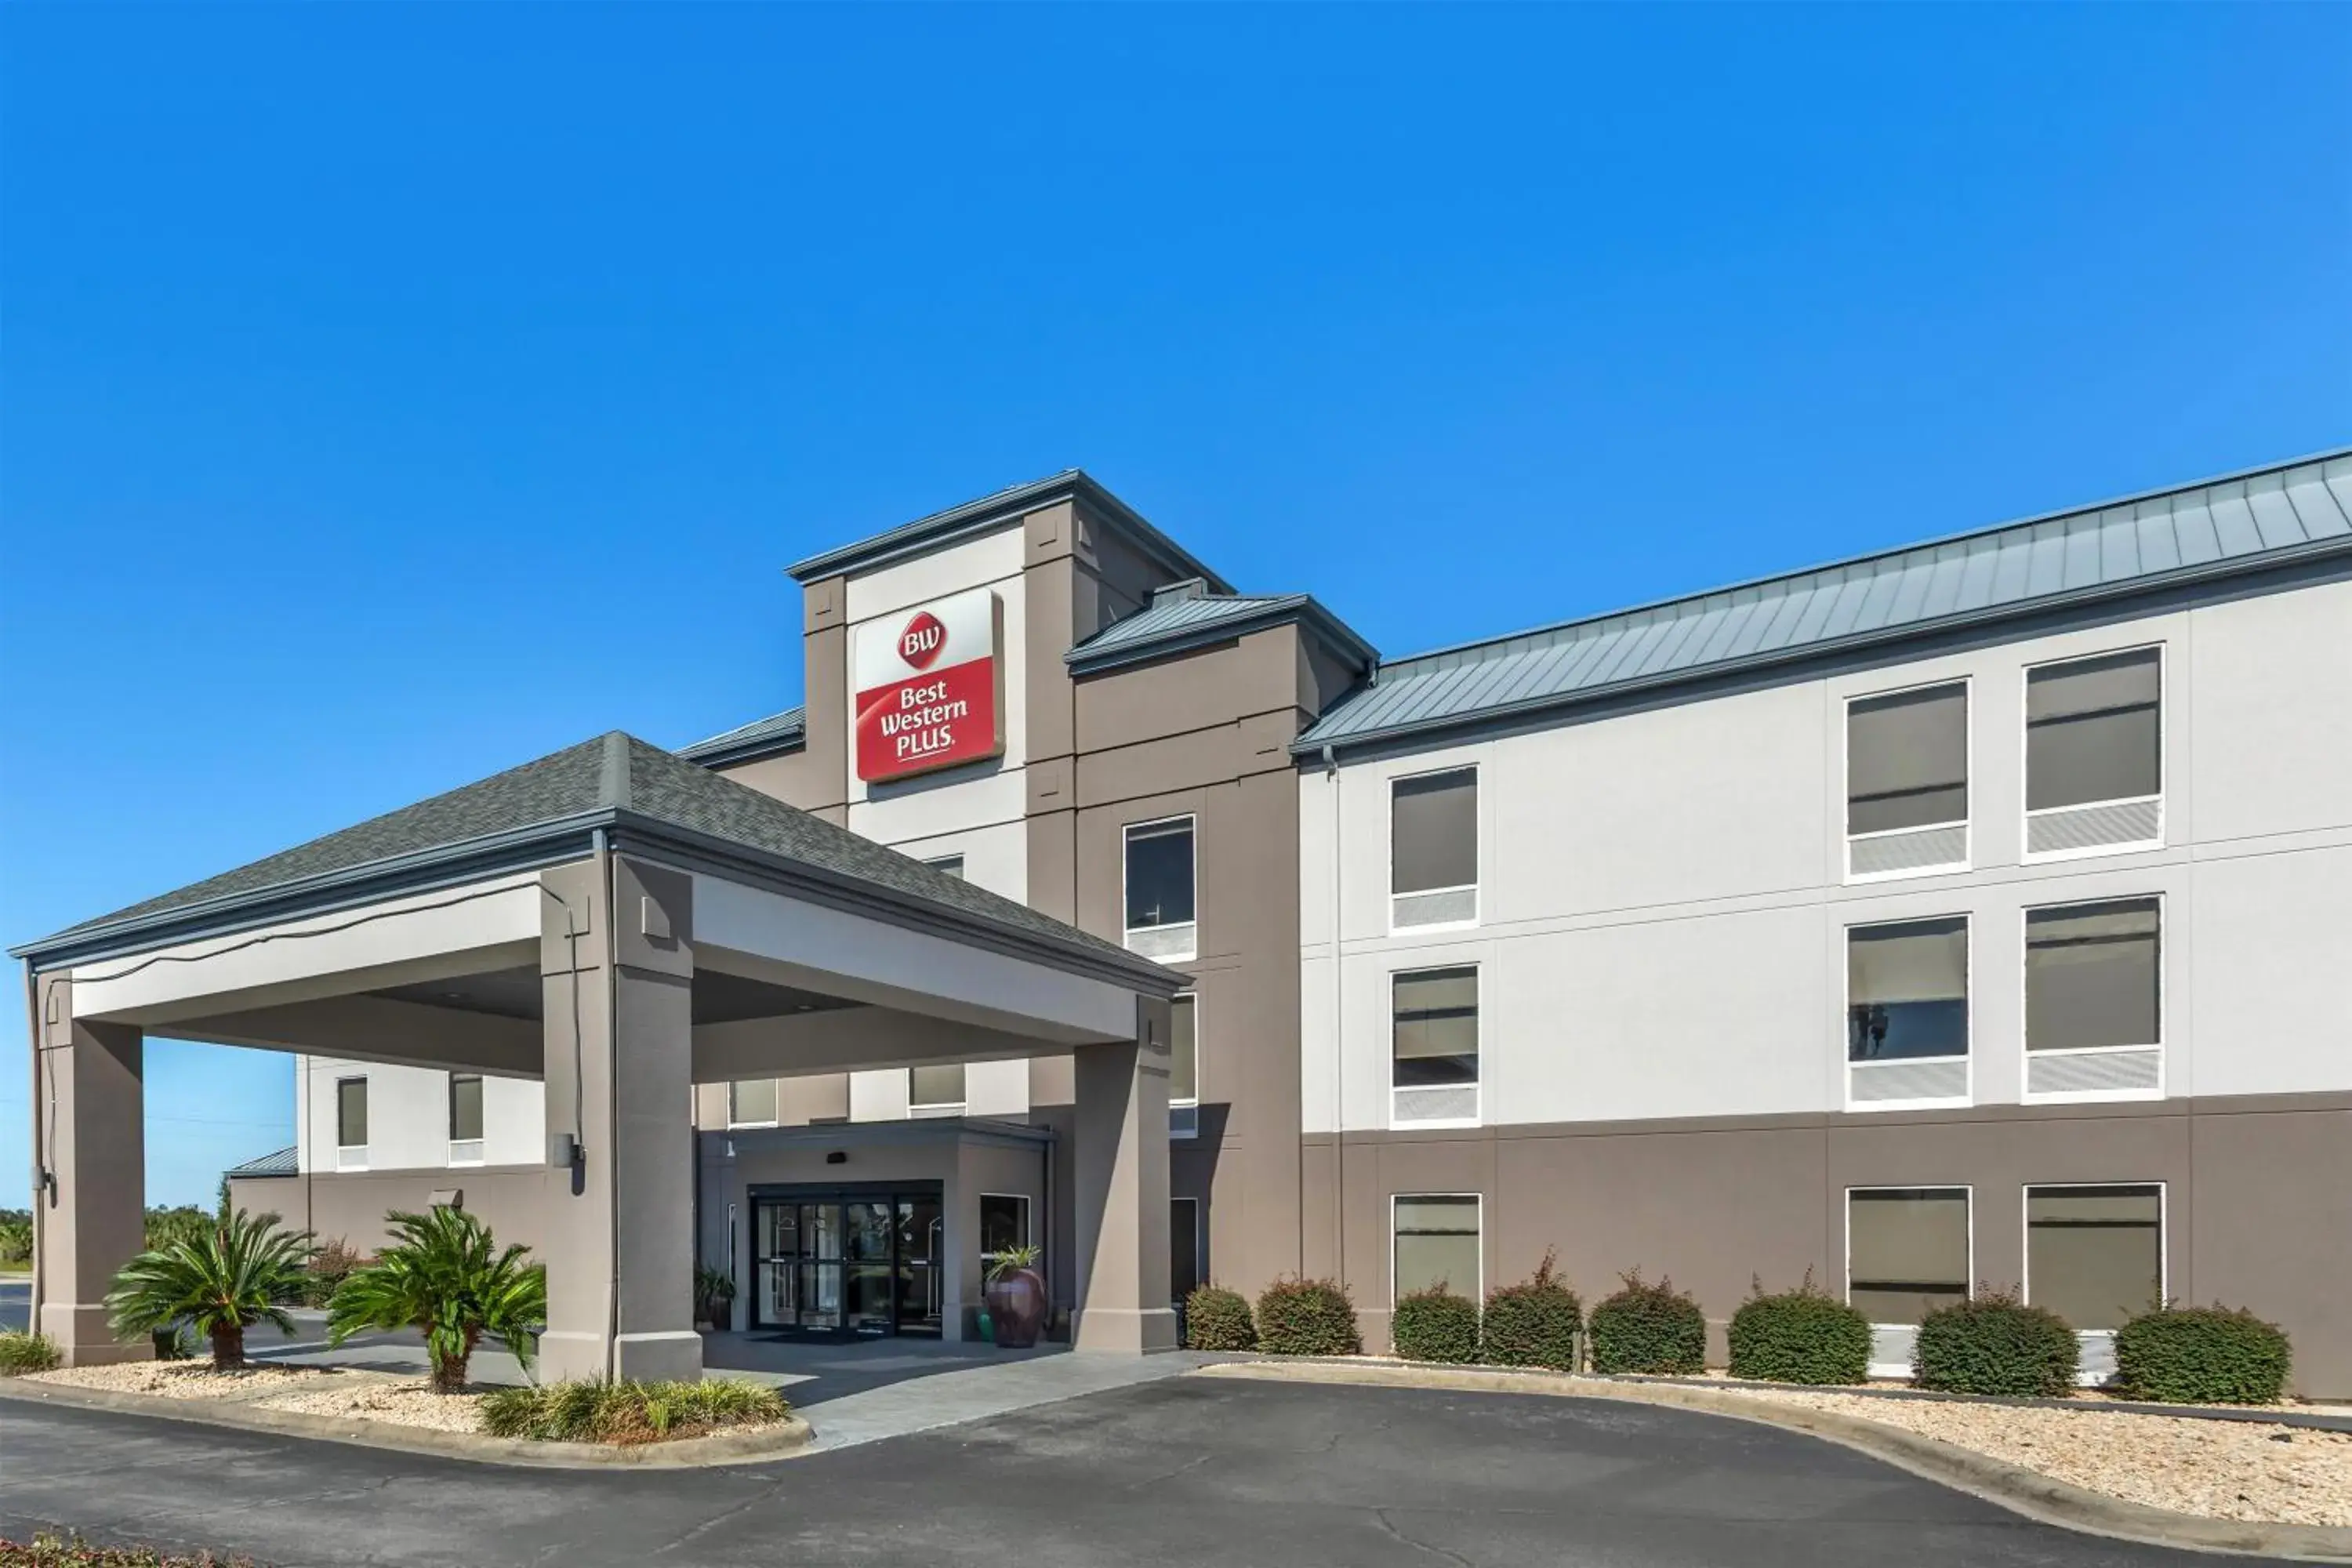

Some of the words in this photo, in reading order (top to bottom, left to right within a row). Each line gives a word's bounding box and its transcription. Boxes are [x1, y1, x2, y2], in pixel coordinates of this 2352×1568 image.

[905, 626, 940, 655] BW
[901, 681, 947, 710] Best
[880, 700, 967, 737] Western
